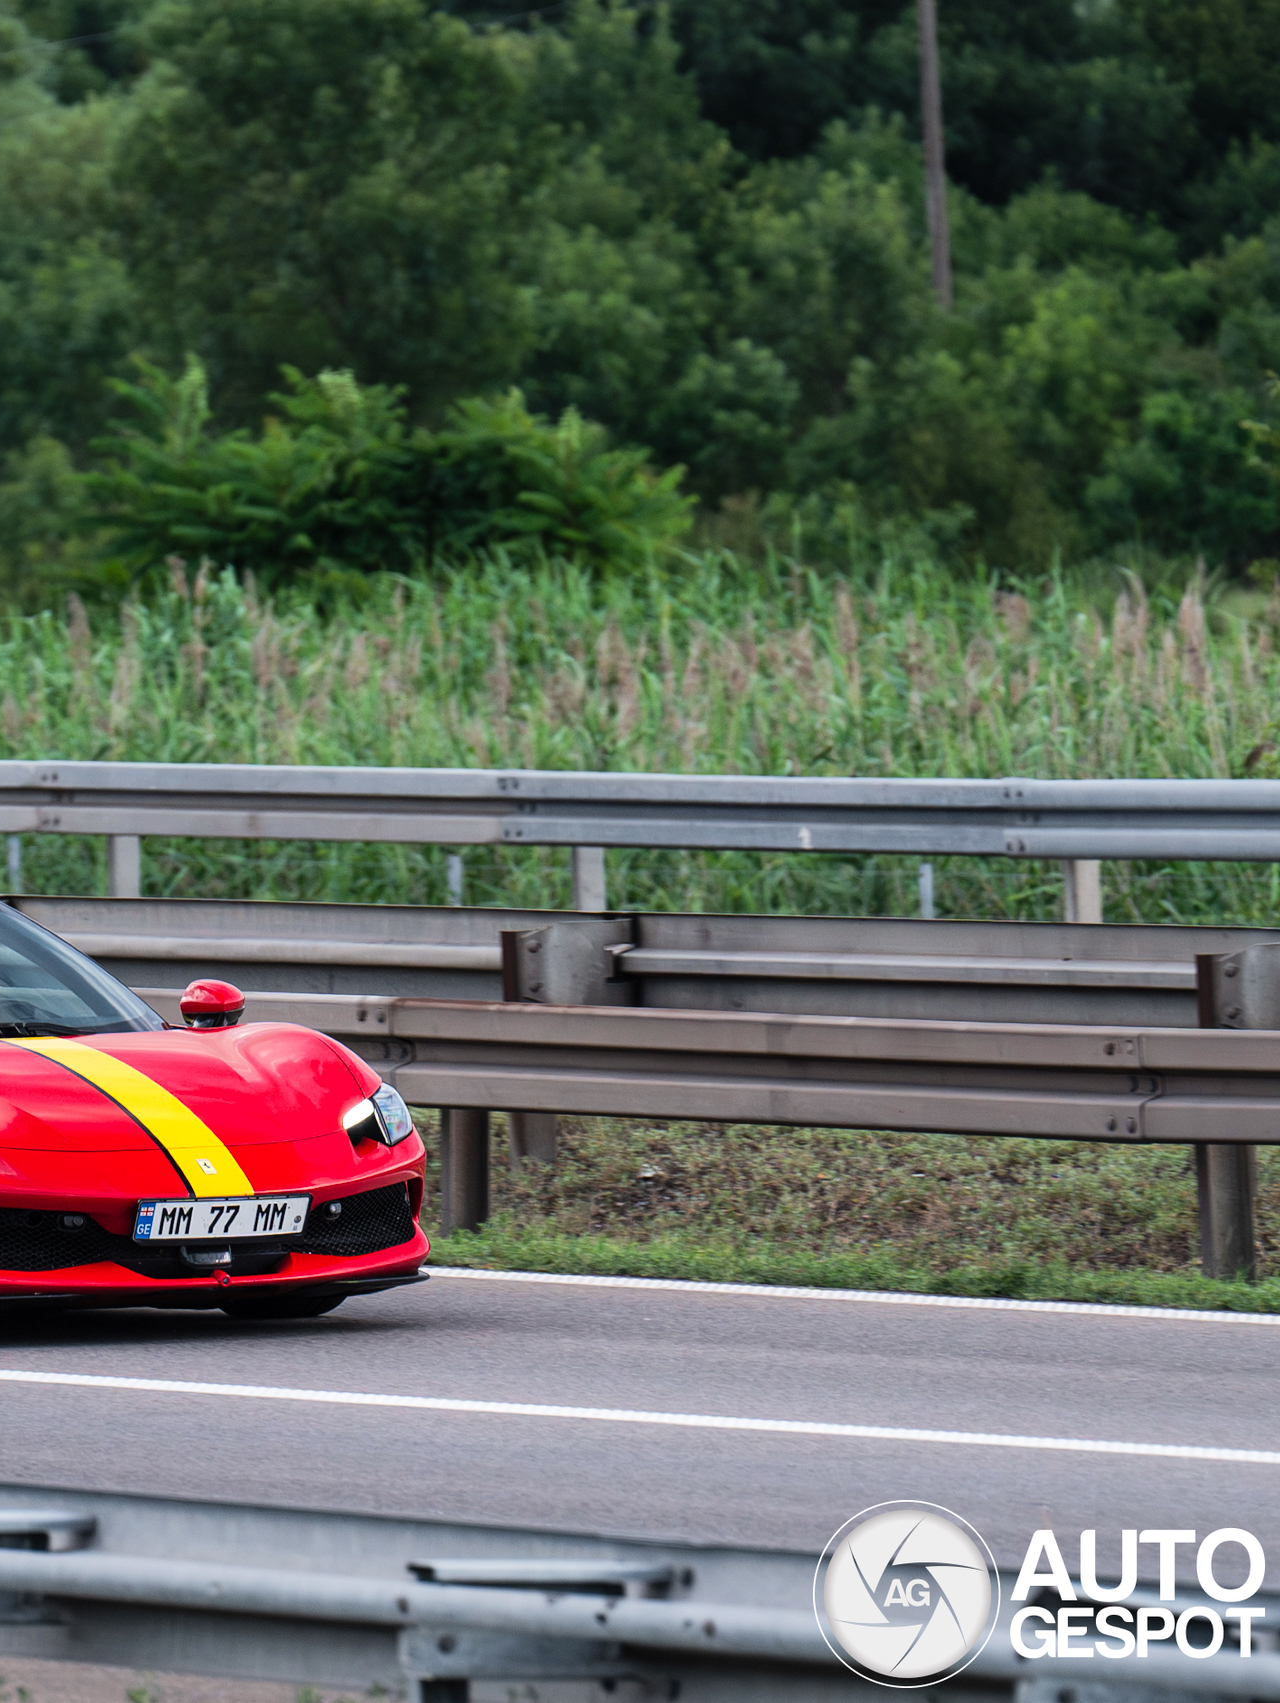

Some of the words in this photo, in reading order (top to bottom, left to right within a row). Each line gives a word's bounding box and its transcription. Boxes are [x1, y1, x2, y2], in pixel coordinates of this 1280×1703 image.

[136, 1224, 151, 1235] GE
[158, 1207, 193, 1235] MM
[208, 1205, 240, 1234] 77
[253, 1203, 287, 1232] MM
